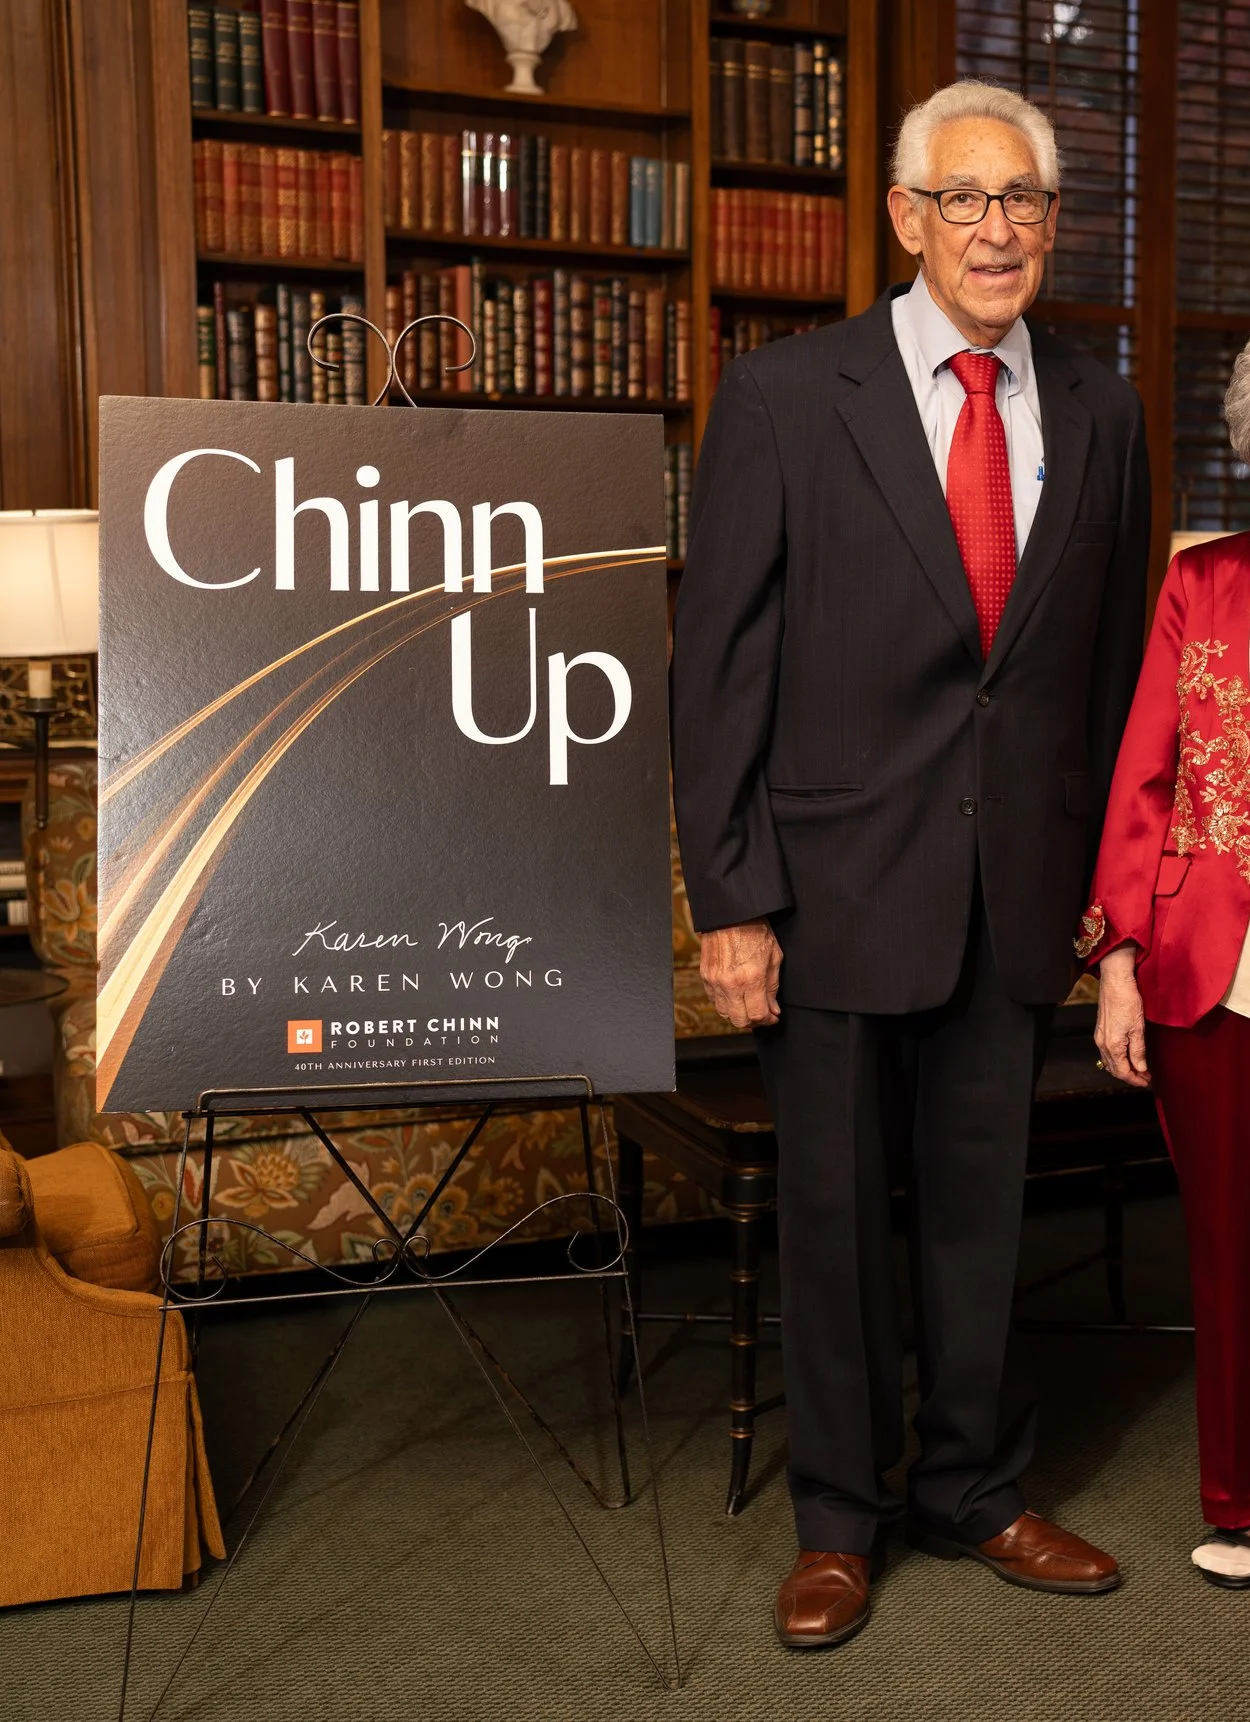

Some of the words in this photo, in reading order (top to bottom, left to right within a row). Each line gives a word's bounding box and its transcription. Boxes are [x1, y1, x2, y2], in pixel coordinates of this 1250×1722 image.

[143, 448, 545, 594] Chinn
[450, 607, 632, 786] Up
[291, 920, 419, 957] Karen
[437, 916, 533, 964] Wong
[221, 977, 263, 996] BY
[294, 973, 419, 994] KAREN
[449, 969, 562, 990] WONG
[330, 1019, 417, 1036] ROBERT
[426, 1016, 499, 1033] CHINN
[331, 1034, 499, 1049] FOUNDATION
[294, 1062, 322, 1071] 40TH
[327, 1059, 407, 1070] ANNIVERSARY
[411, 1058, 443, 1067] FIRST
[448, 1056, 495, 1066] EDITION
